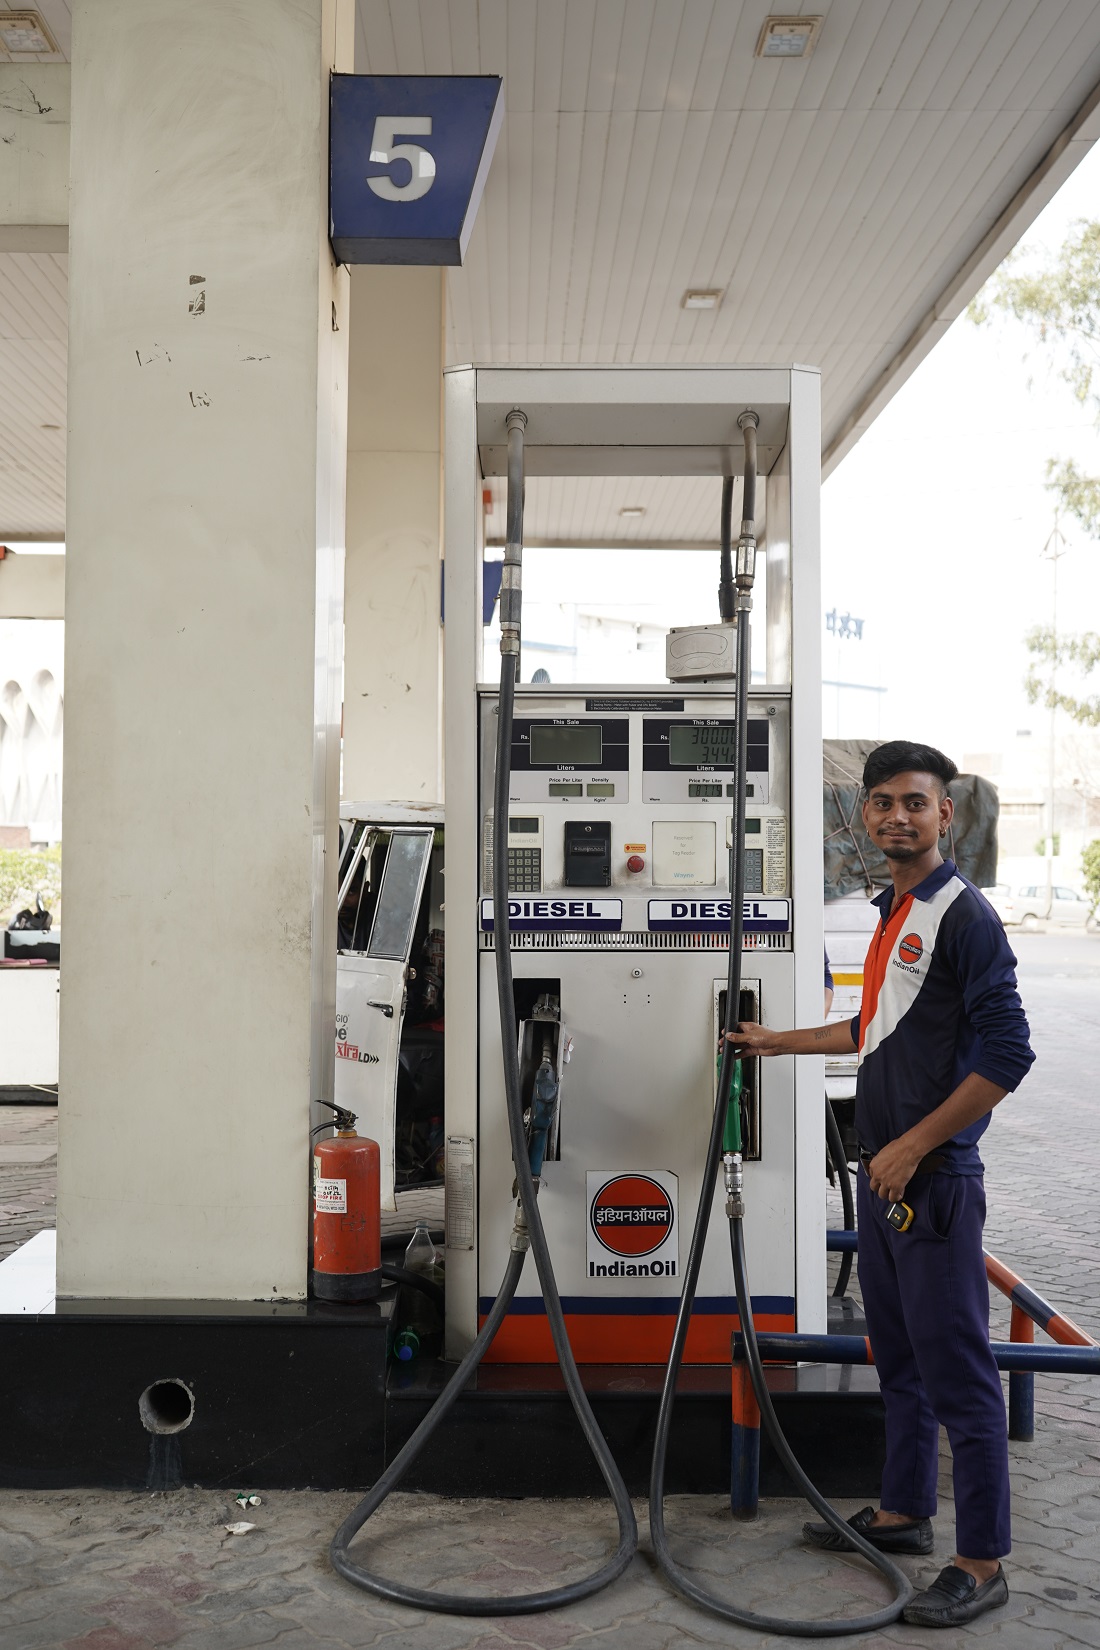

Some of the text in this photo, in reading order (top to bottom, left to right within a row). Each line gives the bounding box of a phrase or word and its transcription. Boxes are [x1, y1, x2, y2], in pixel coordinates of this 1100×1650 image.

[366, 115, 436, 202] 5
[508, 902, 602, 917] DIESEL
[892, 958, 920, 975] IndianOil
[596, 1207, 669, 1225] इंडियनऑयल
[589, 1260, 676, 1277] IndianOil
